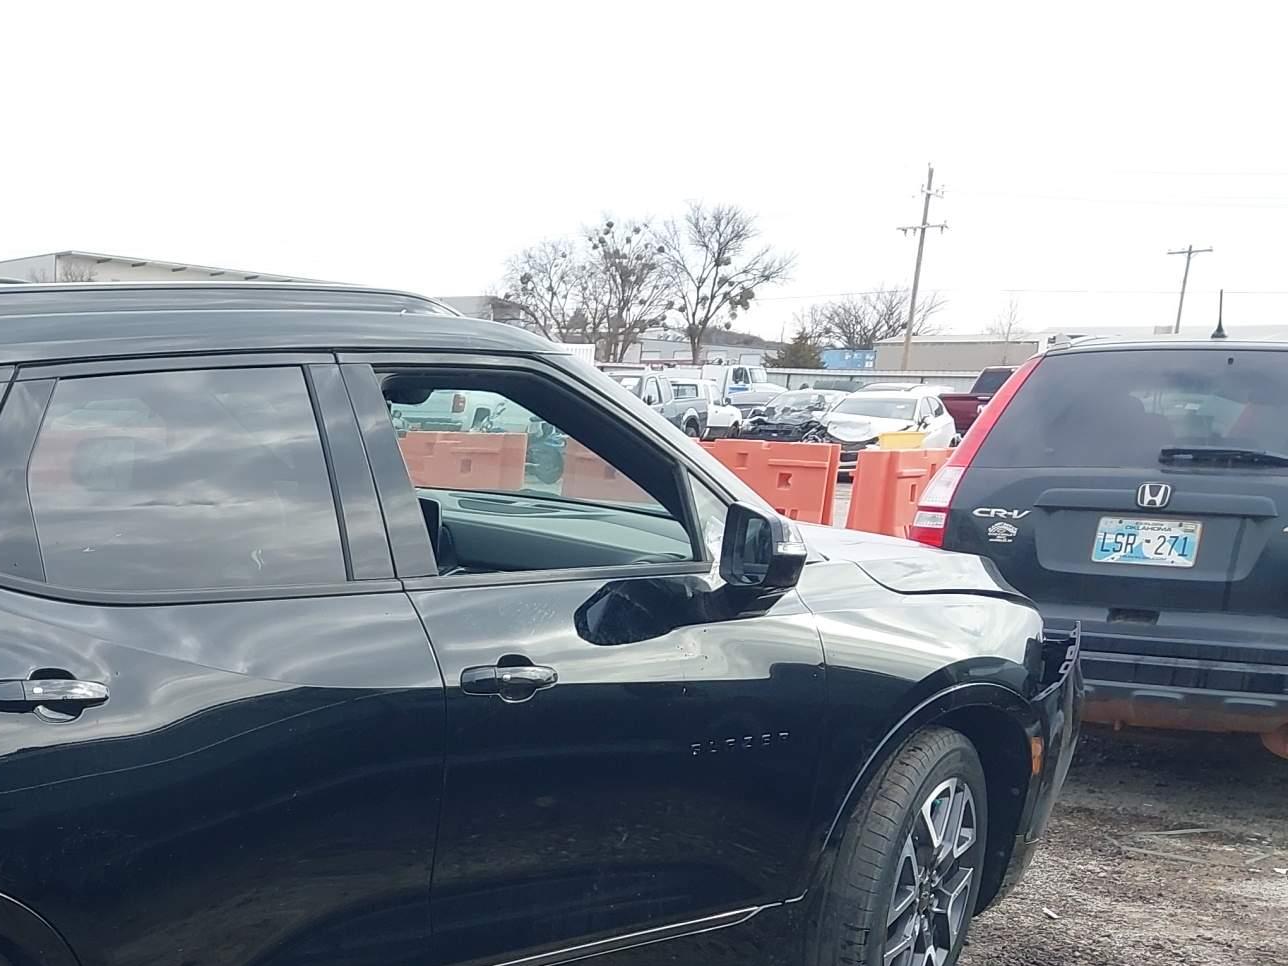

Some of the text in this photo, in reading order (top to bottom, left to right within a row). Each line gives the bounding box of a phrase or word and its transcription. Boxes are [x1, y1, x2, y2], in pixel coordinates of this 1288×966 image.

[972, 507, 1032, 519] CR-V
[1125, 525, 1172, 533] OKLAHOMA
[1100, 532, 1137, 554] LSR
[1154, 534, 1190, 557] 271
